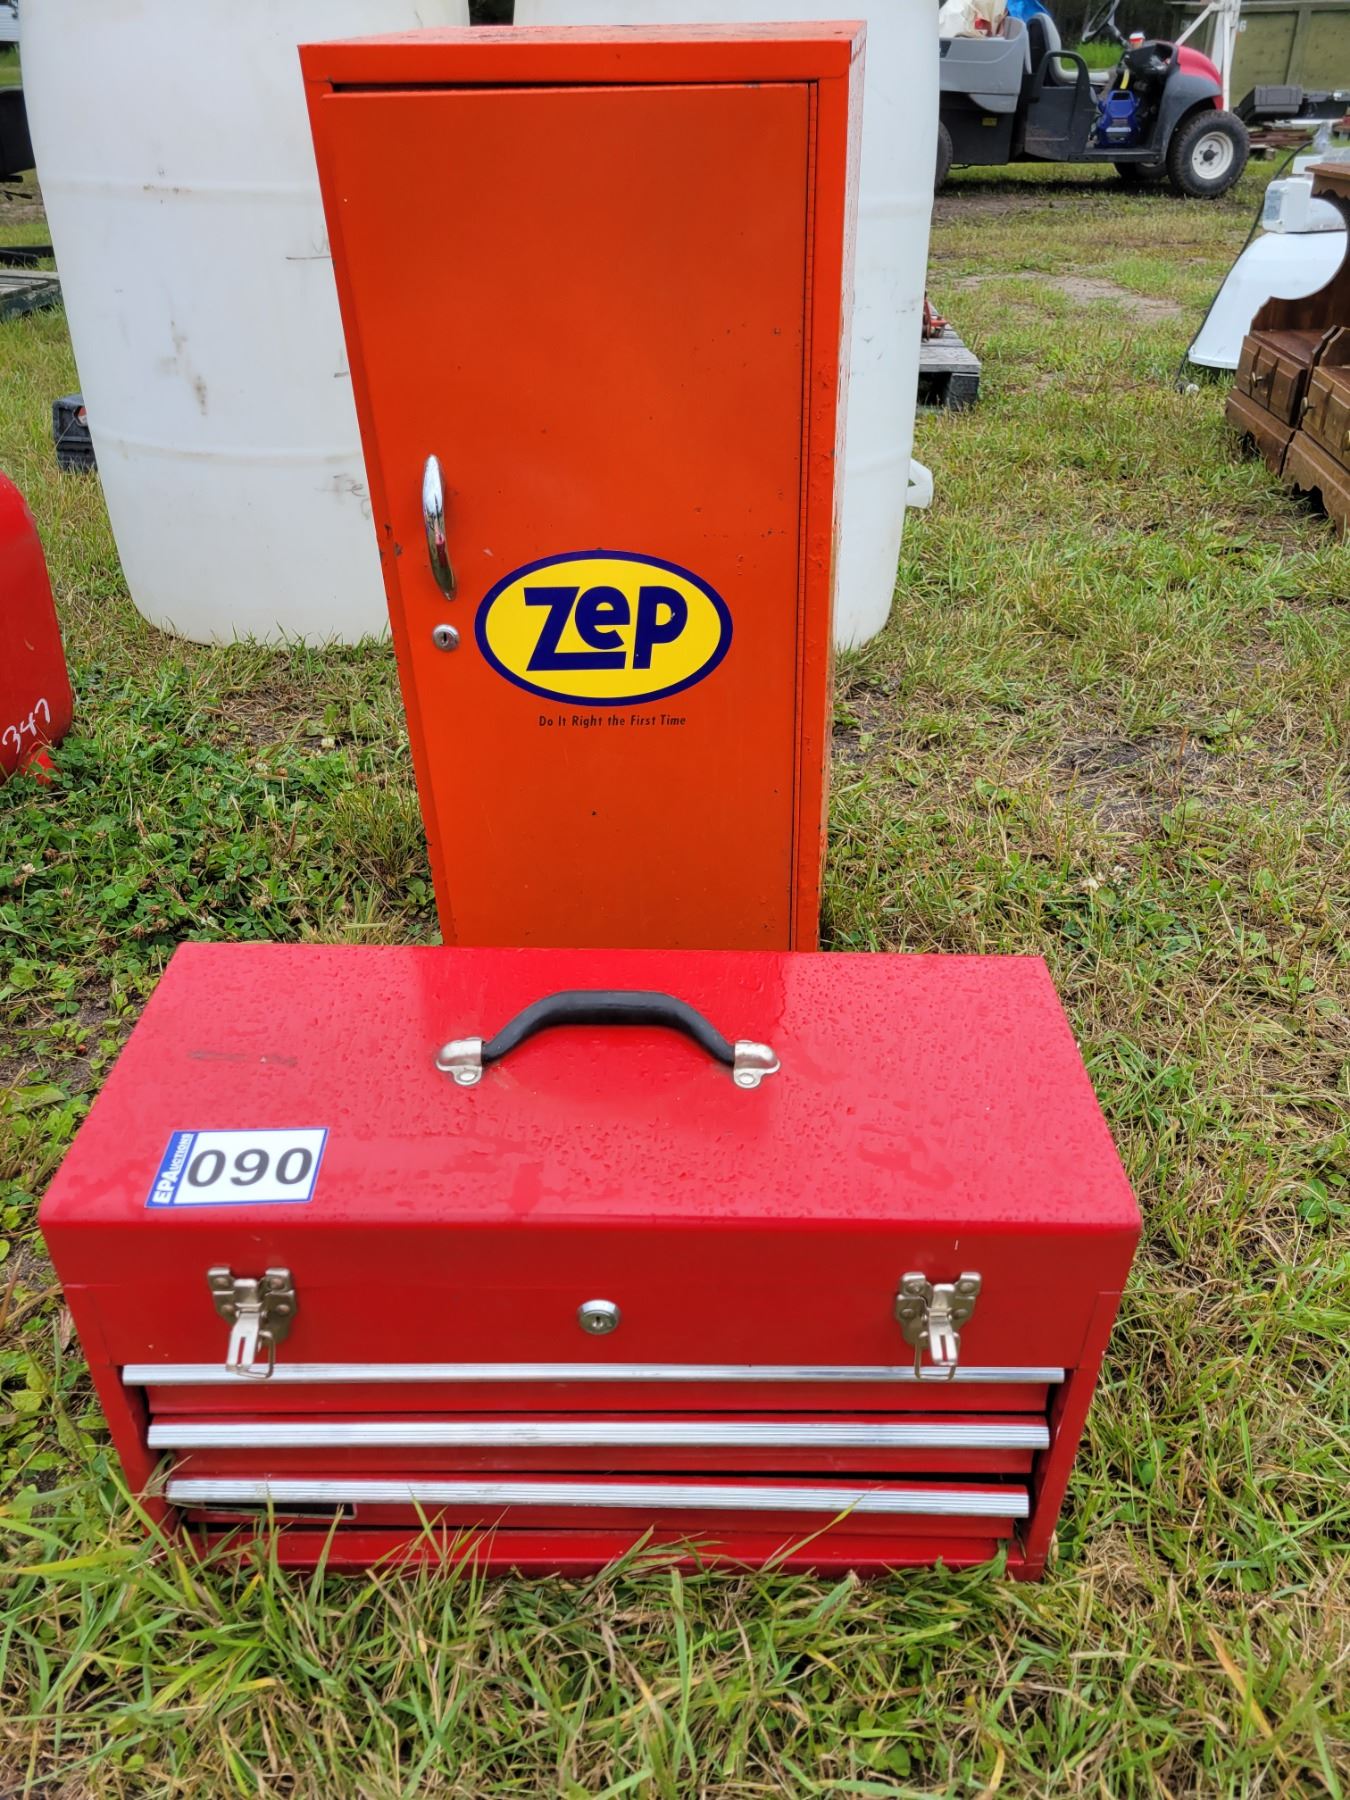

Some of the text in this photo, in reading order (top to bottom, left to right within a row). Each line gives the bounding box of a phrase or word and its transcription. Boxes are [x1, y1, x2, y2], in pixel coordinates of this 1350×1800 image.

[1, 697, 51, 755] 347
[539, 714, 686, 729] Do It Right the First Time
[187, 1147, 313, 1188] 090
